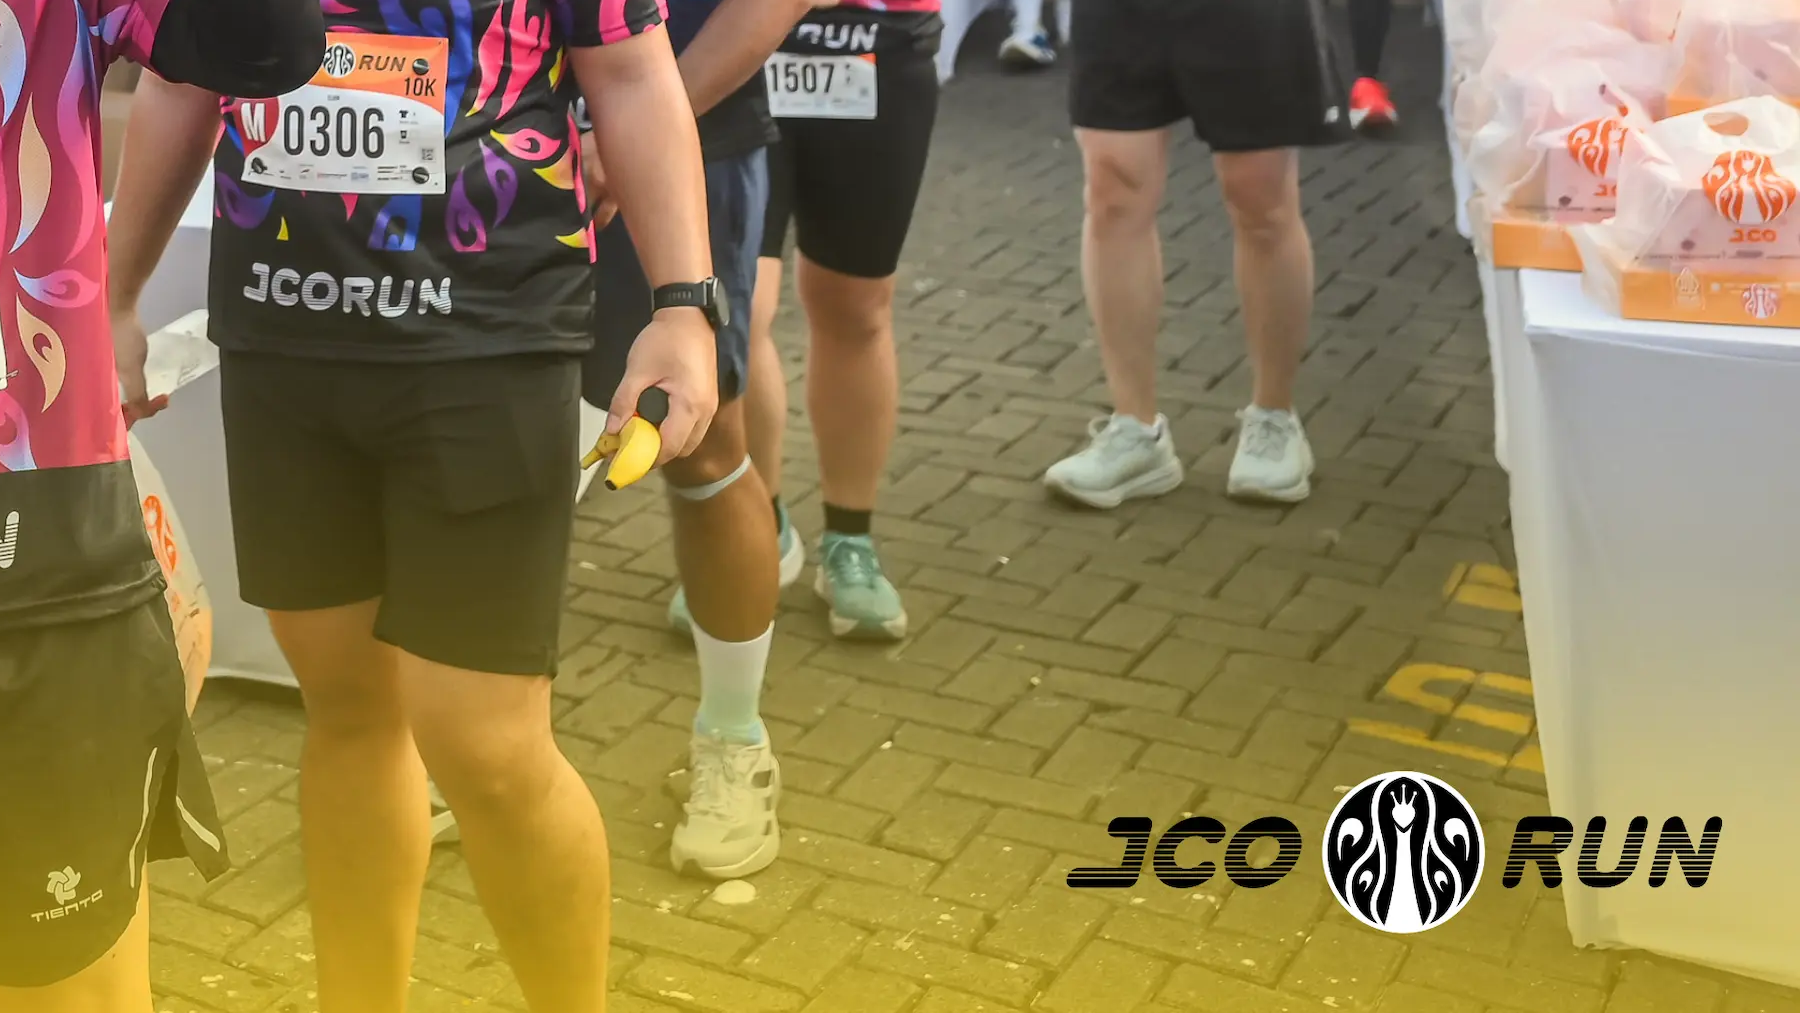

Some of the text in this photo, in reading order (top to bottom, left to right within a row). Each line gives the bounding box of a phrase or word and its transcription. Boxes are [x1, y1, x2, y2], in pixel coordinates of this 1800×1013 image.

[358, 54, 407, 72] RUN
[404, 77, 436, 97] 10K
[770, 62, 835, 93] 1507
[240, 102, 385, 159] M 0306
[1729, 228, 1777, 243] JCO
[243, 261, 452, 318] JCORUN
